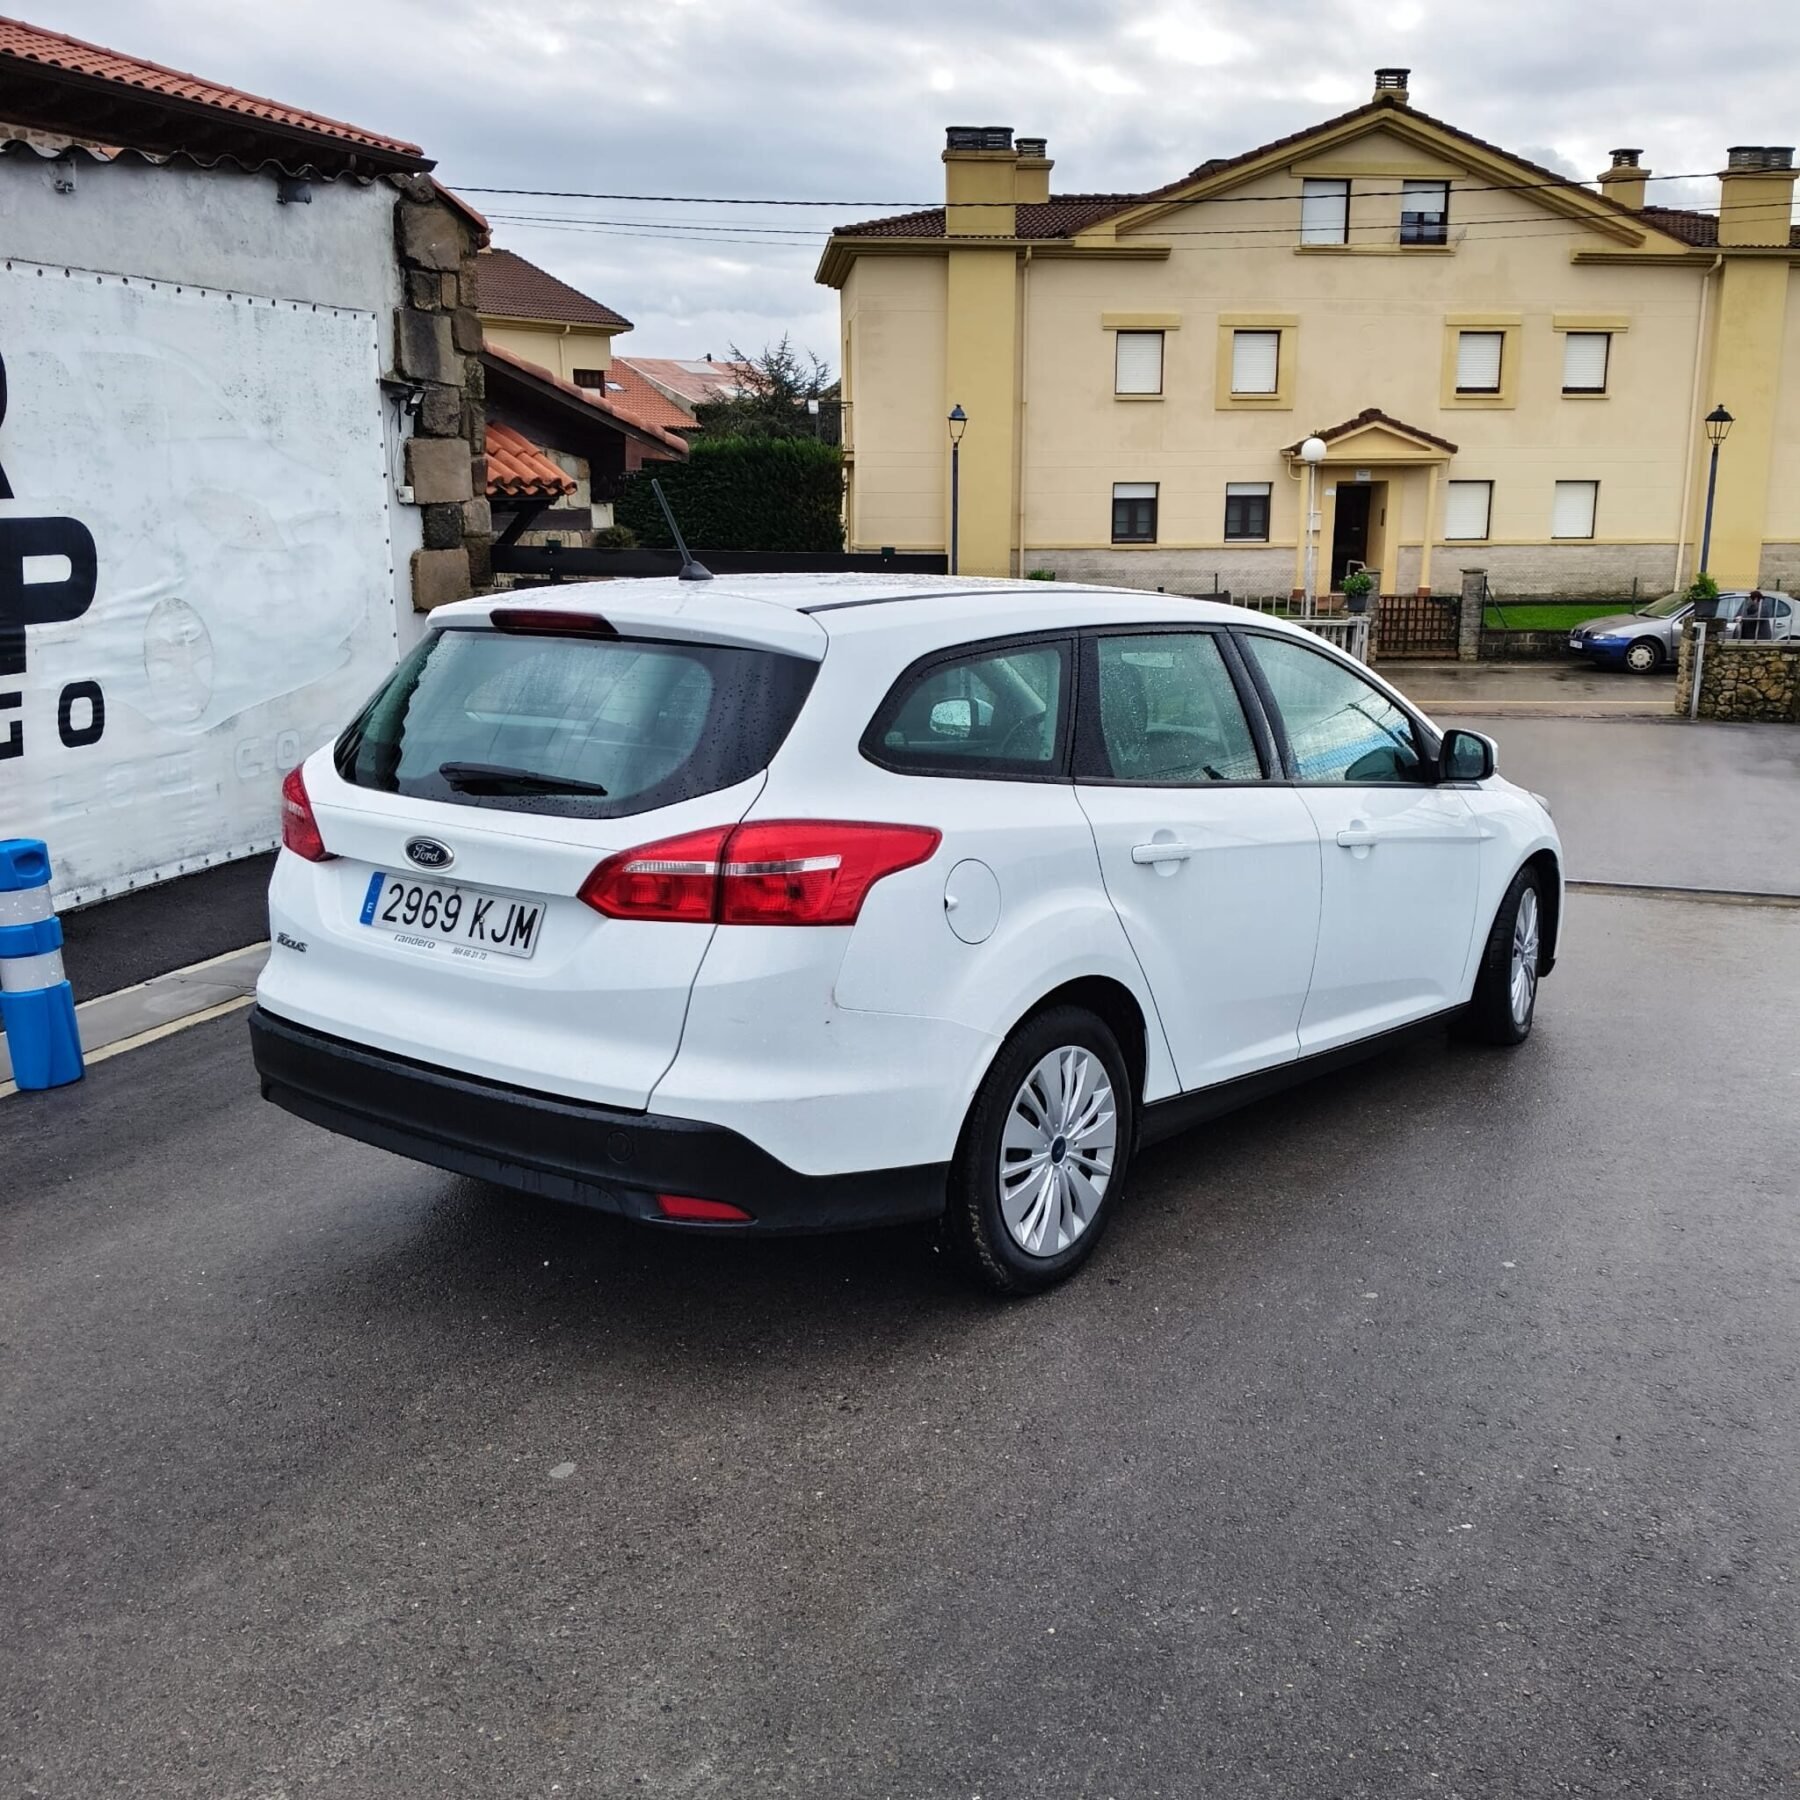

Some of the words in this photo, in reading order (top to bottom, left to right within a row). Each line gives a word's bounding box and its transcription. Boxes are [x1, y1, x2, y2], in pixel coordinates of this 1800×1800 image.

[412, 843, 440, 863] Ford
[366, 902, 373, 912] E
[382, 883, 462, 933] 2969
[468, 898, 538, 949] KJM
